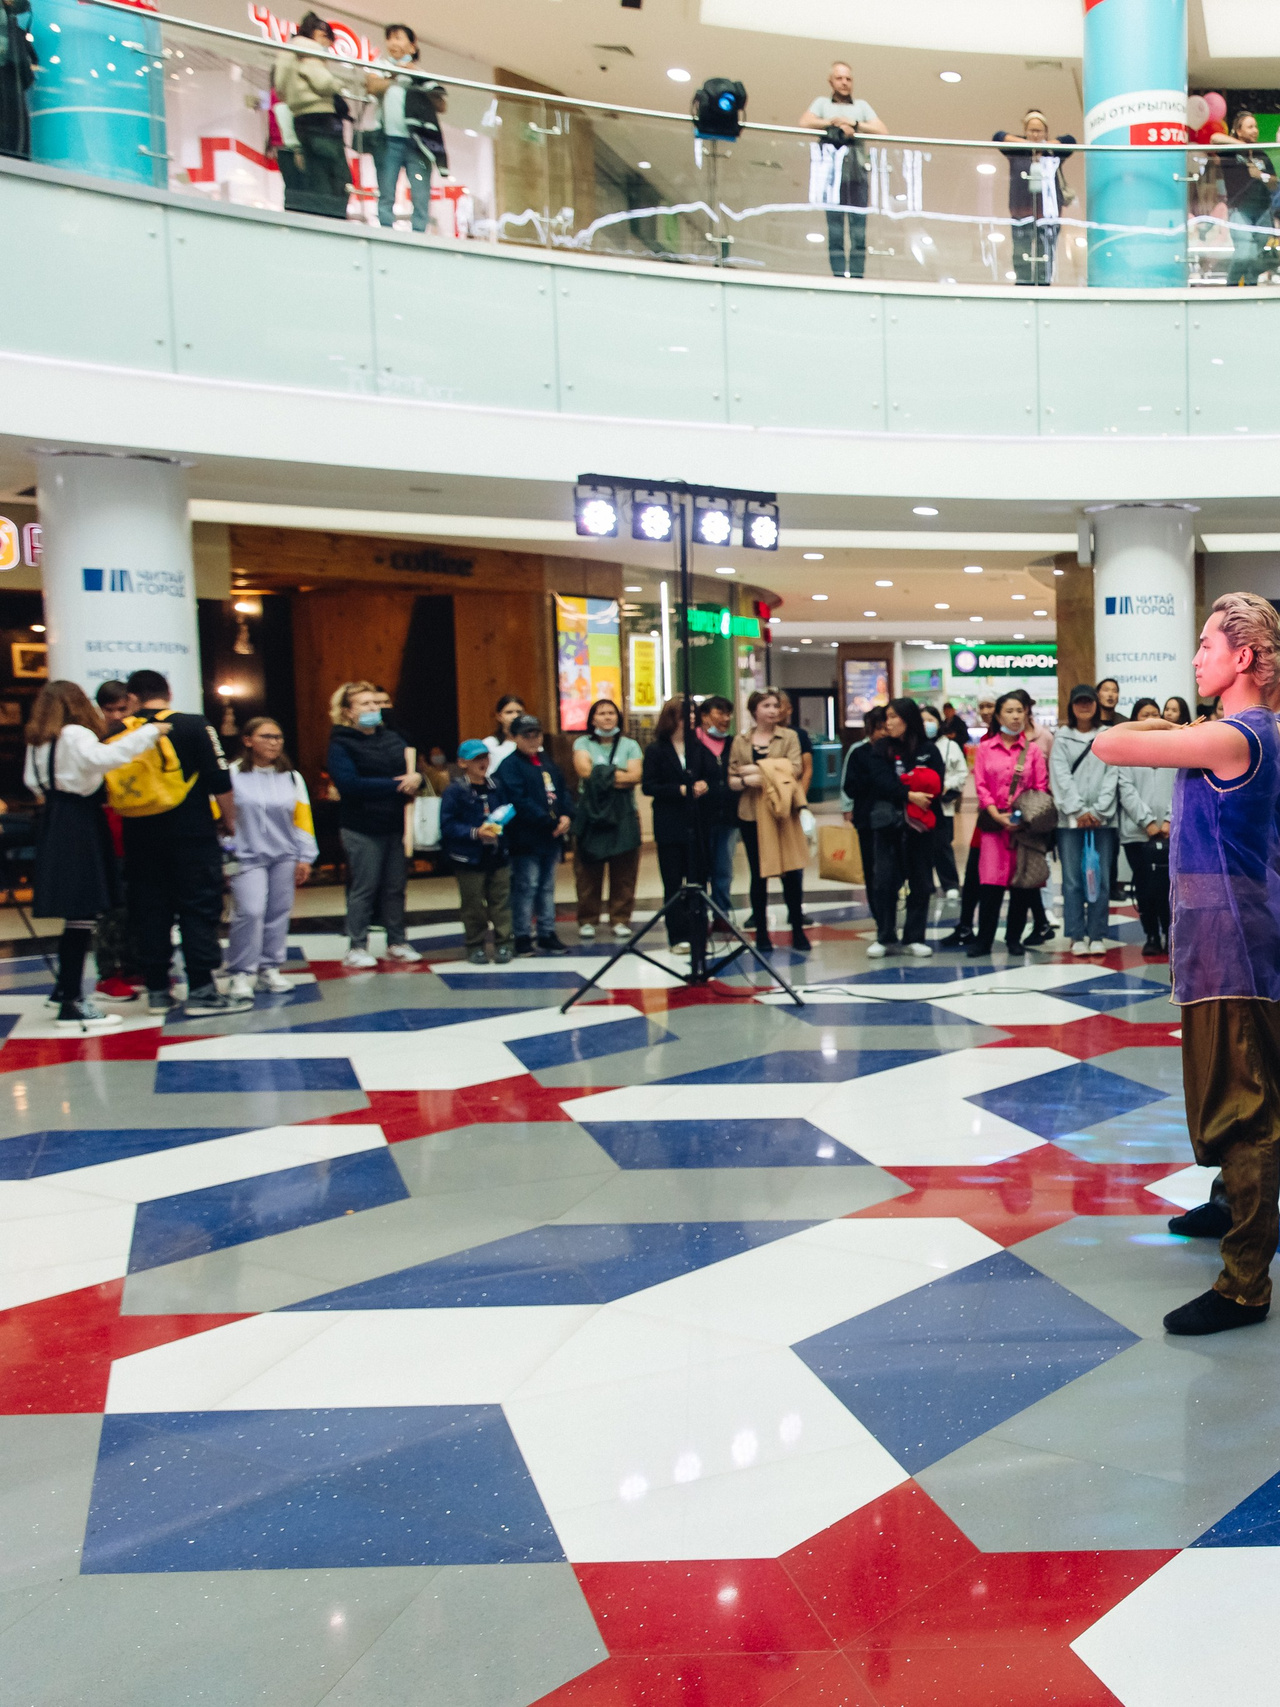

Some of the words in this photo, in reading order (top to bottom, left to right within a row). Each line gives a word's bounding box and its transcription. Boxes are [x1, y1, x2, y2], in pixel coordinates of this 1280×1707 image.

[1109, 101, 1187, 120] ОТКРЫЛИС
[1147, 127, 1158, 142] 3
[1160, 127, 1187, 143] ЭТА
[1136, 594, 1175, 605] ЧИТАЙ
[1136, 605, 1175, 616] ГОРОД
[1105, 652, 1176, 663] БЕСТСЕЛЛЕРЫ
